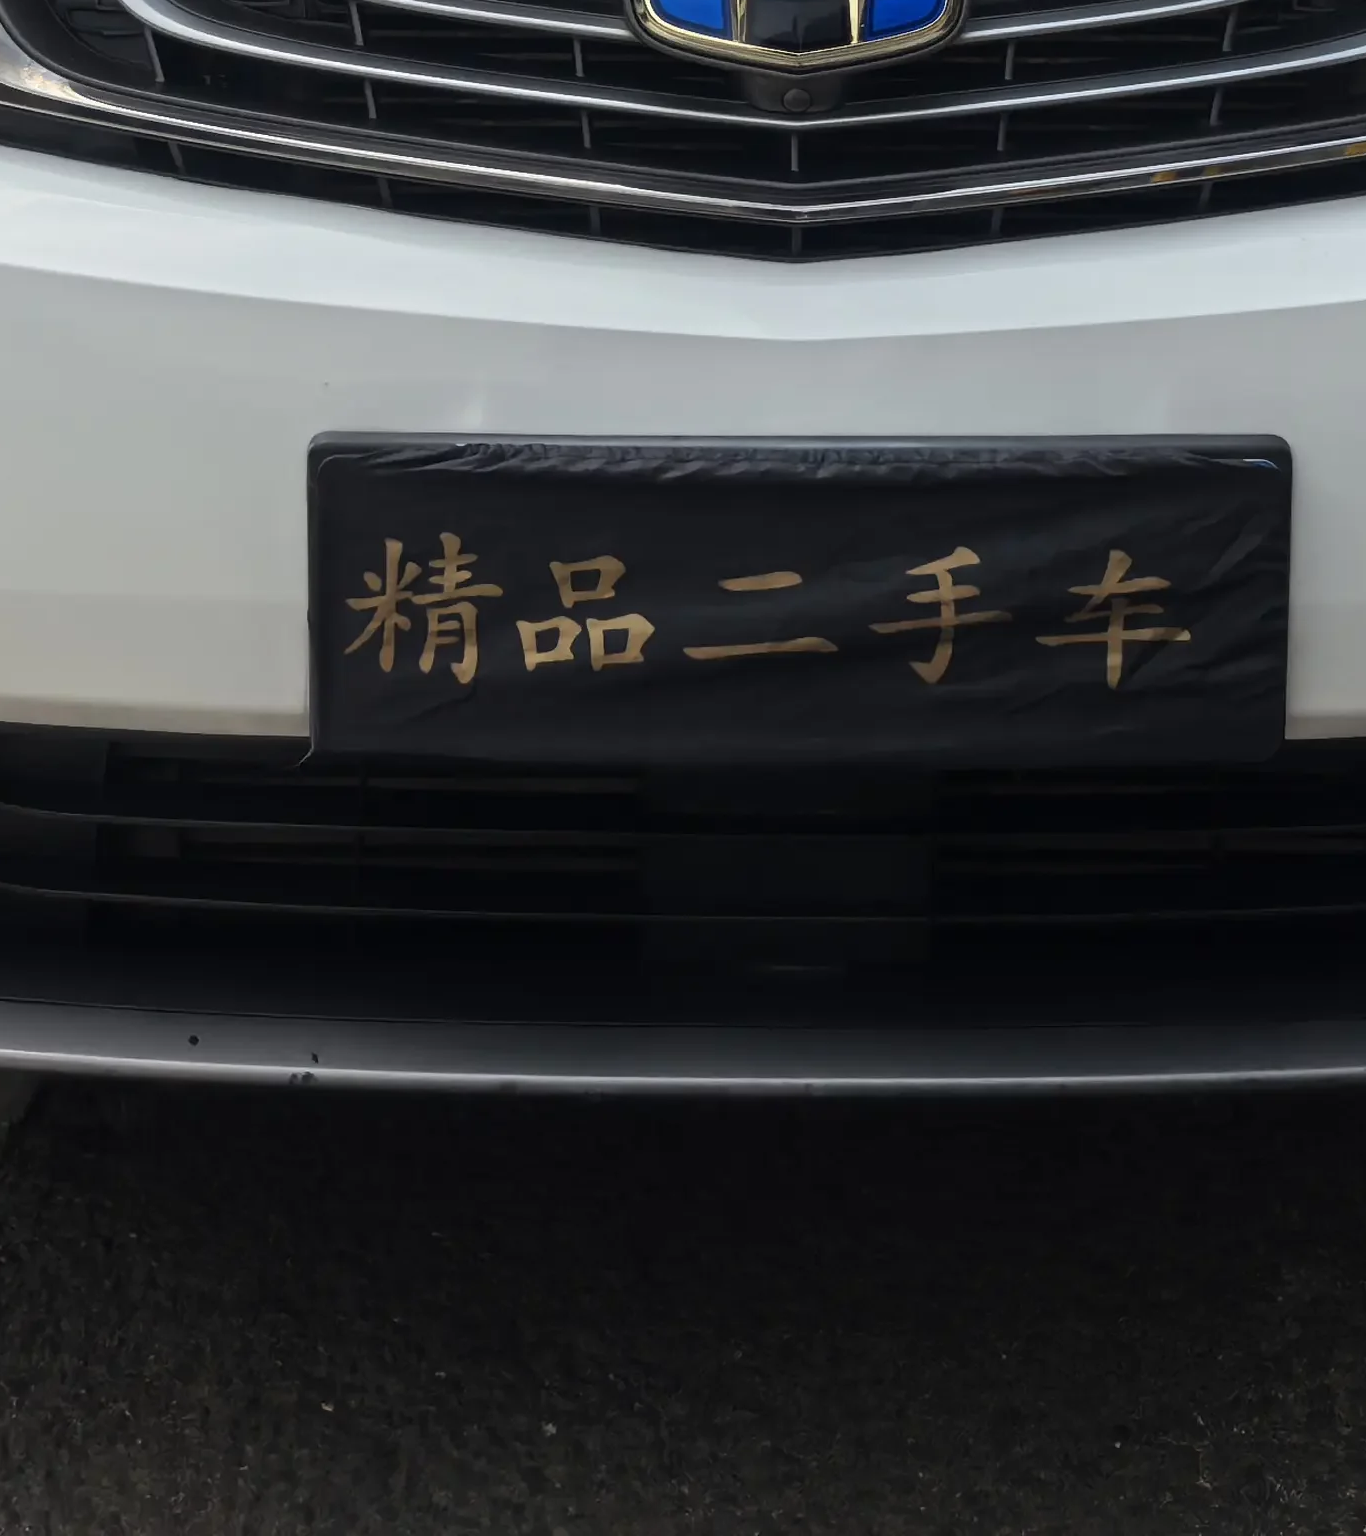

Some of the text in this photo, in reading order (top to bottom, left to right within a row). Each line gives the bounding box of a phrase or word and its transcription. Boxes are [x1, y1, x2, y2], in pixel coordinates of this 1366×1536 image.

[343, 531, 1192, 690] 精品二手车
